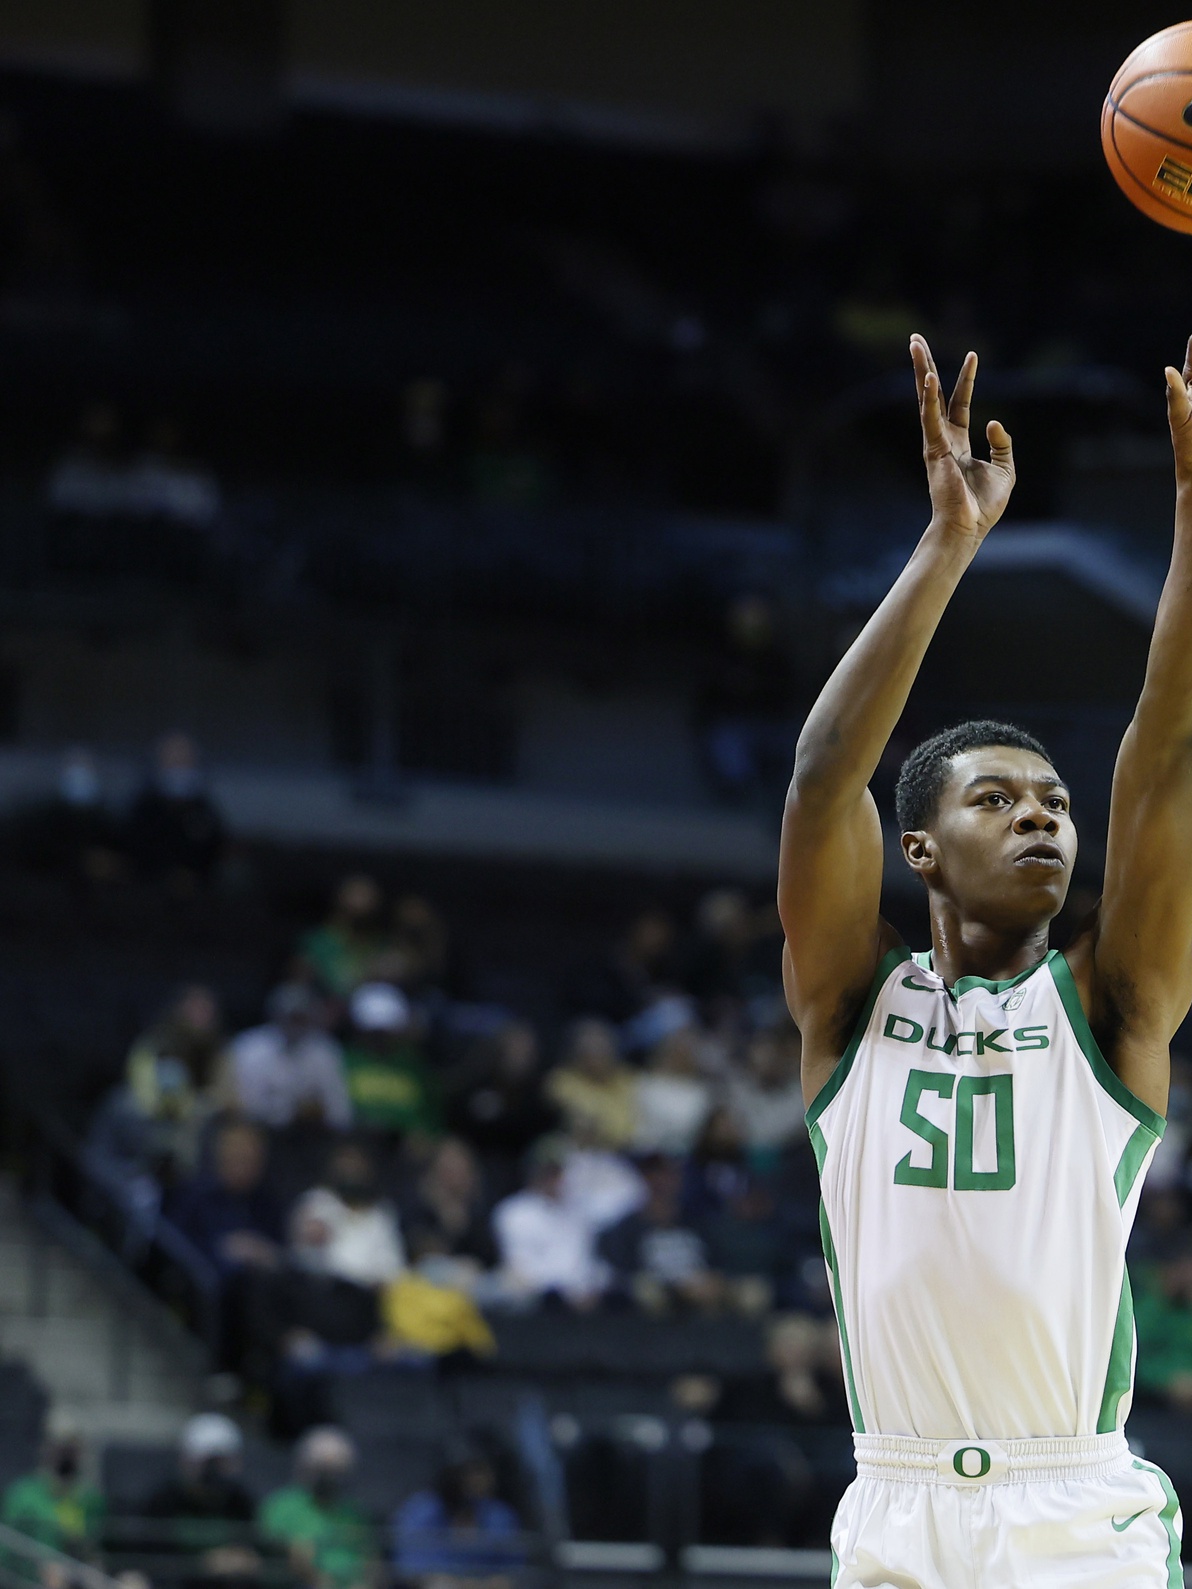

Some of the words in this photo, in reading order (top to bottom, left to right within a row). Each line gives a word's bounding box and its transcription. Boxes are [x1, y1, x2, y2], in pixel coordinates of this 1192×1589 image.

[883, 1013, 1050, 1056] DUCKS
[893, 1068, 1016, 1191] 50
[953, 1446, 991, 1478] O
